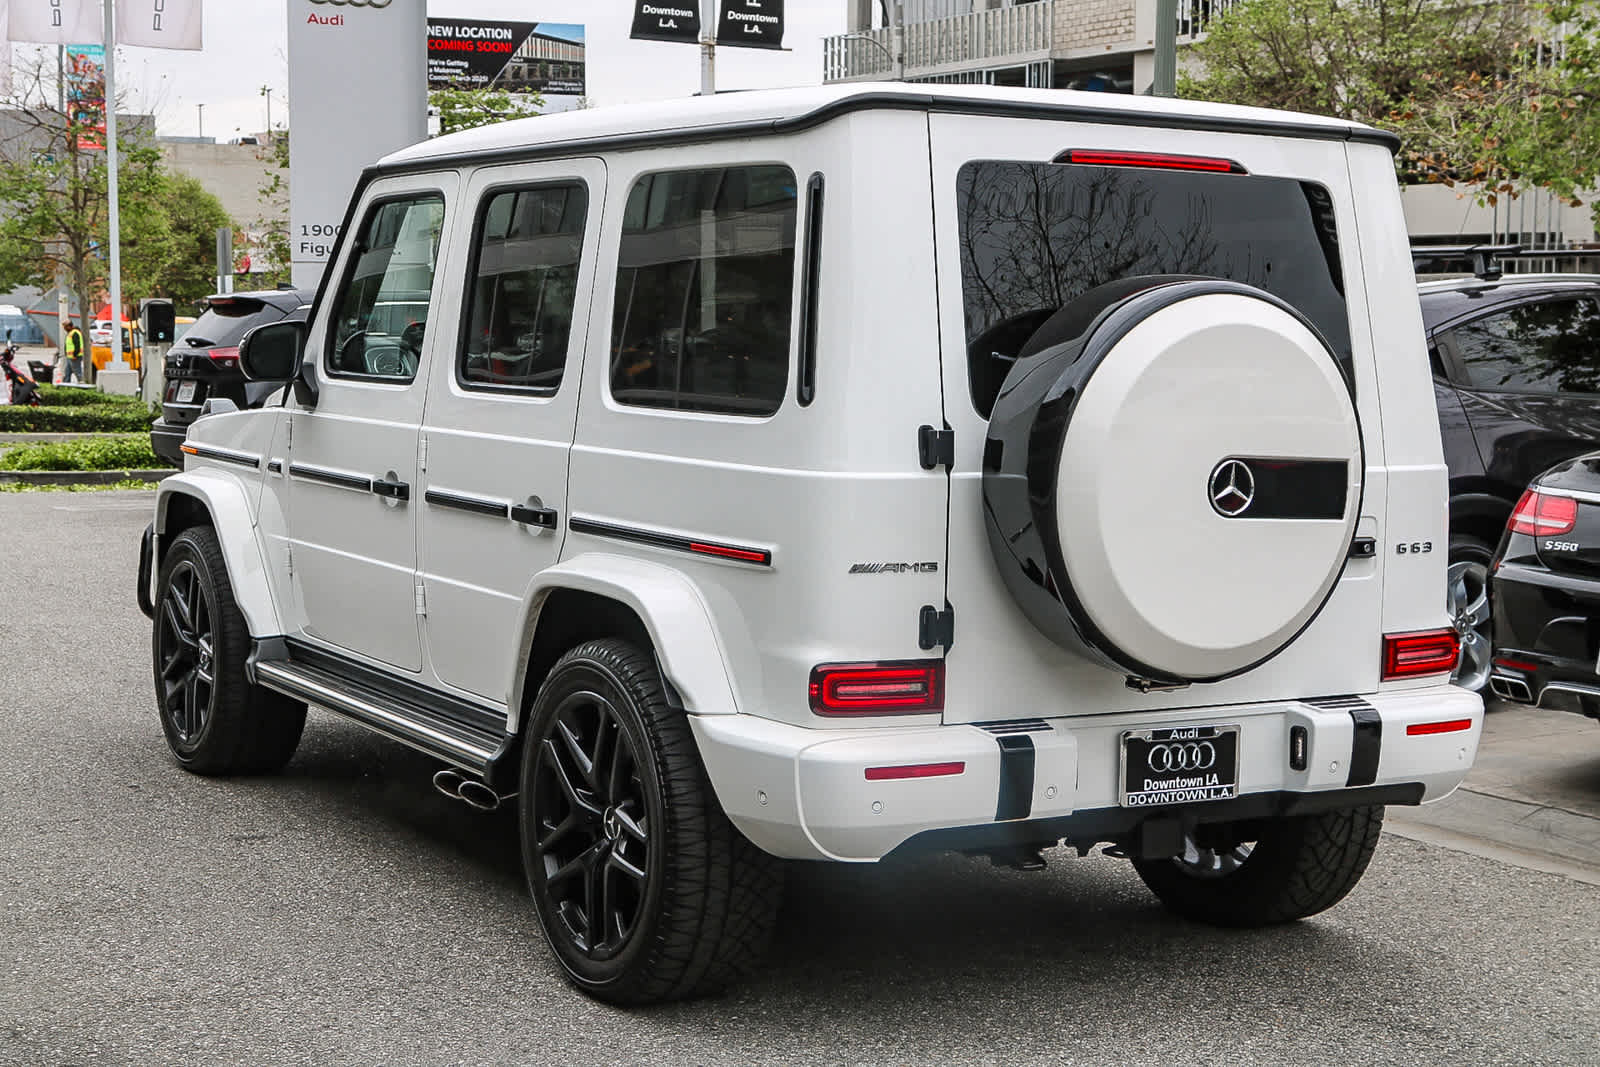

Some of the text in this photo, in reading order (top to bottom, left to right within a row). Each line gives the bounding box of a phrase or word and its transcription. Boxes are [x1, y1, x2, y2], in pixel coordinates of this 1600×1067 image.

[642, 4, 694, 18] Downtown
[727, 10, 779, 24] Downtown
[307, 12, 344, 26] Audi
[658, 18, 678, 28] L.A.
[426, 25, 512, 39] NEW LOCATION
[743, 24, 762, 34] L.A.
[428, 39, 512, 53] COMING SOON!
[876, 561, 938, 574] AMG
[1170, 727, 1199, 740] Audi
[1143, 773, 1219, 791] Downtown LA
[1128, 787, 1233, 806] DOWNTOWN L.A.
